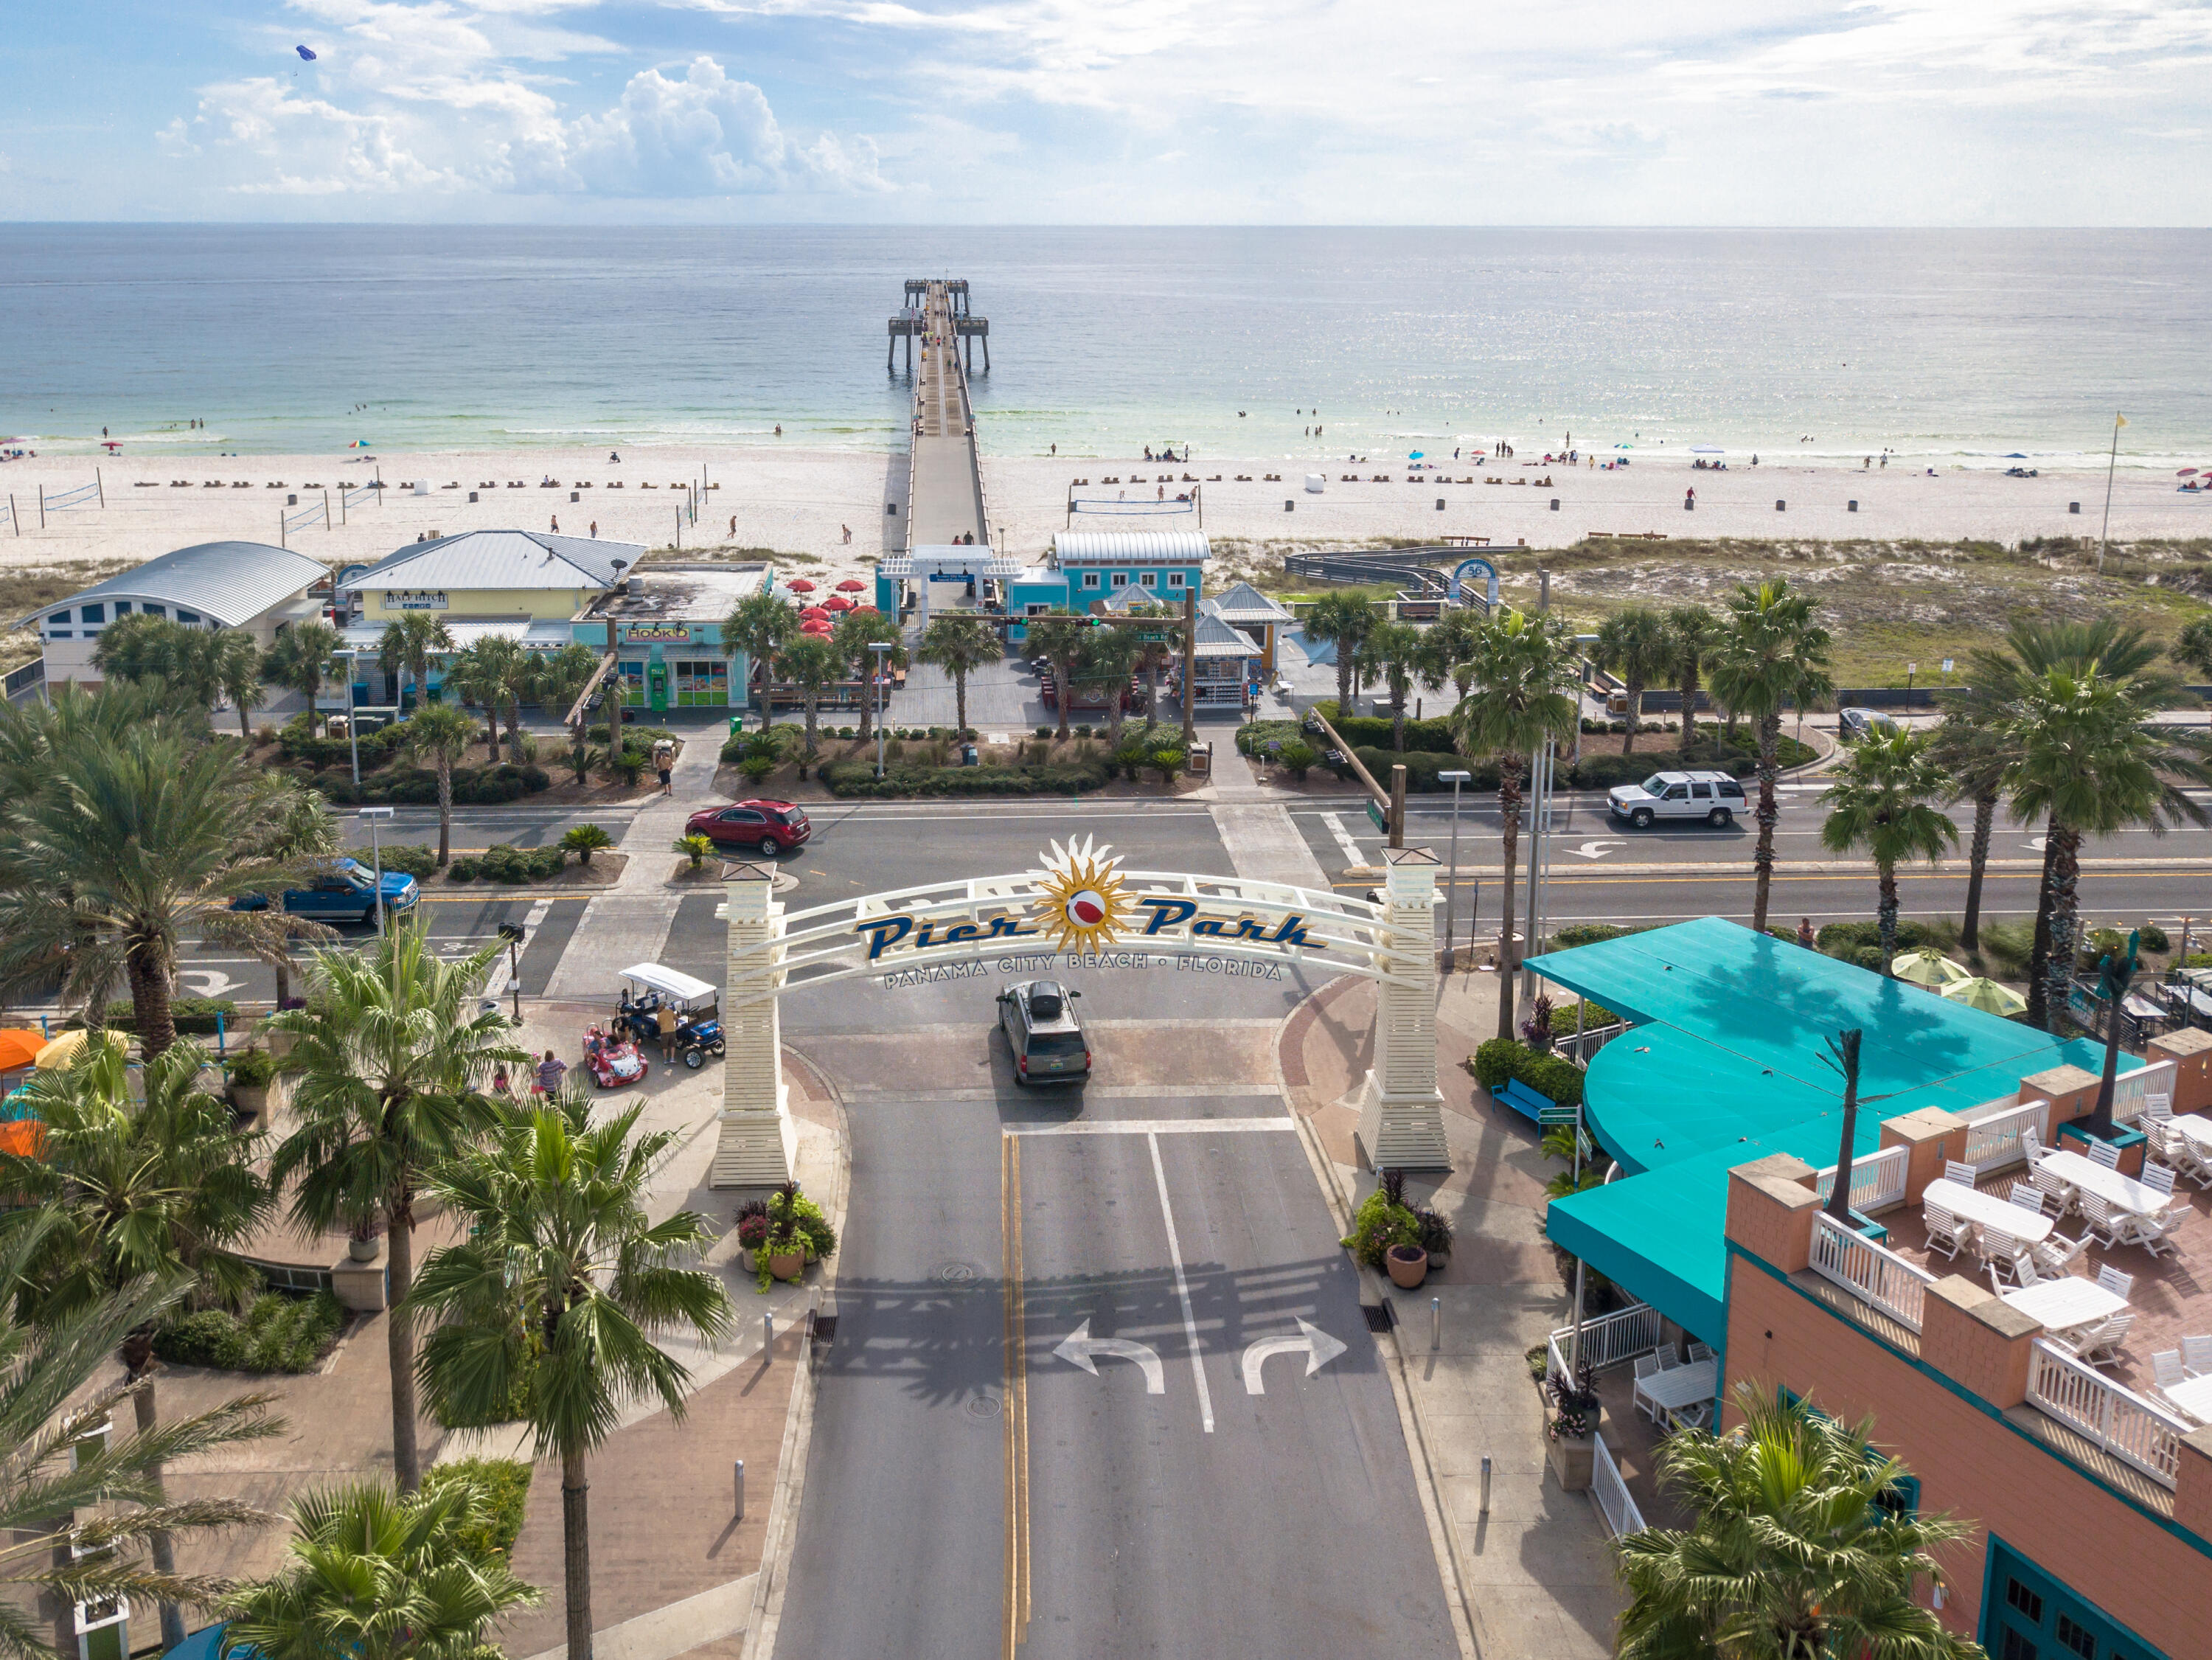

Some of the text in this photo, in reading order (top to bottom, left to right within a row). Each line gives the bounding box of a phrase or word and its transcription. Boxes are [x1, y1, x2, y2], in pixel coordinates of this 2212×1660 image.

[1468, 566, 1482, 575] 56
[852, 895, 1329, 960] Pier Park
[884, 951, 1282, 990] PANAMA CITY BEACH FLORIDA
